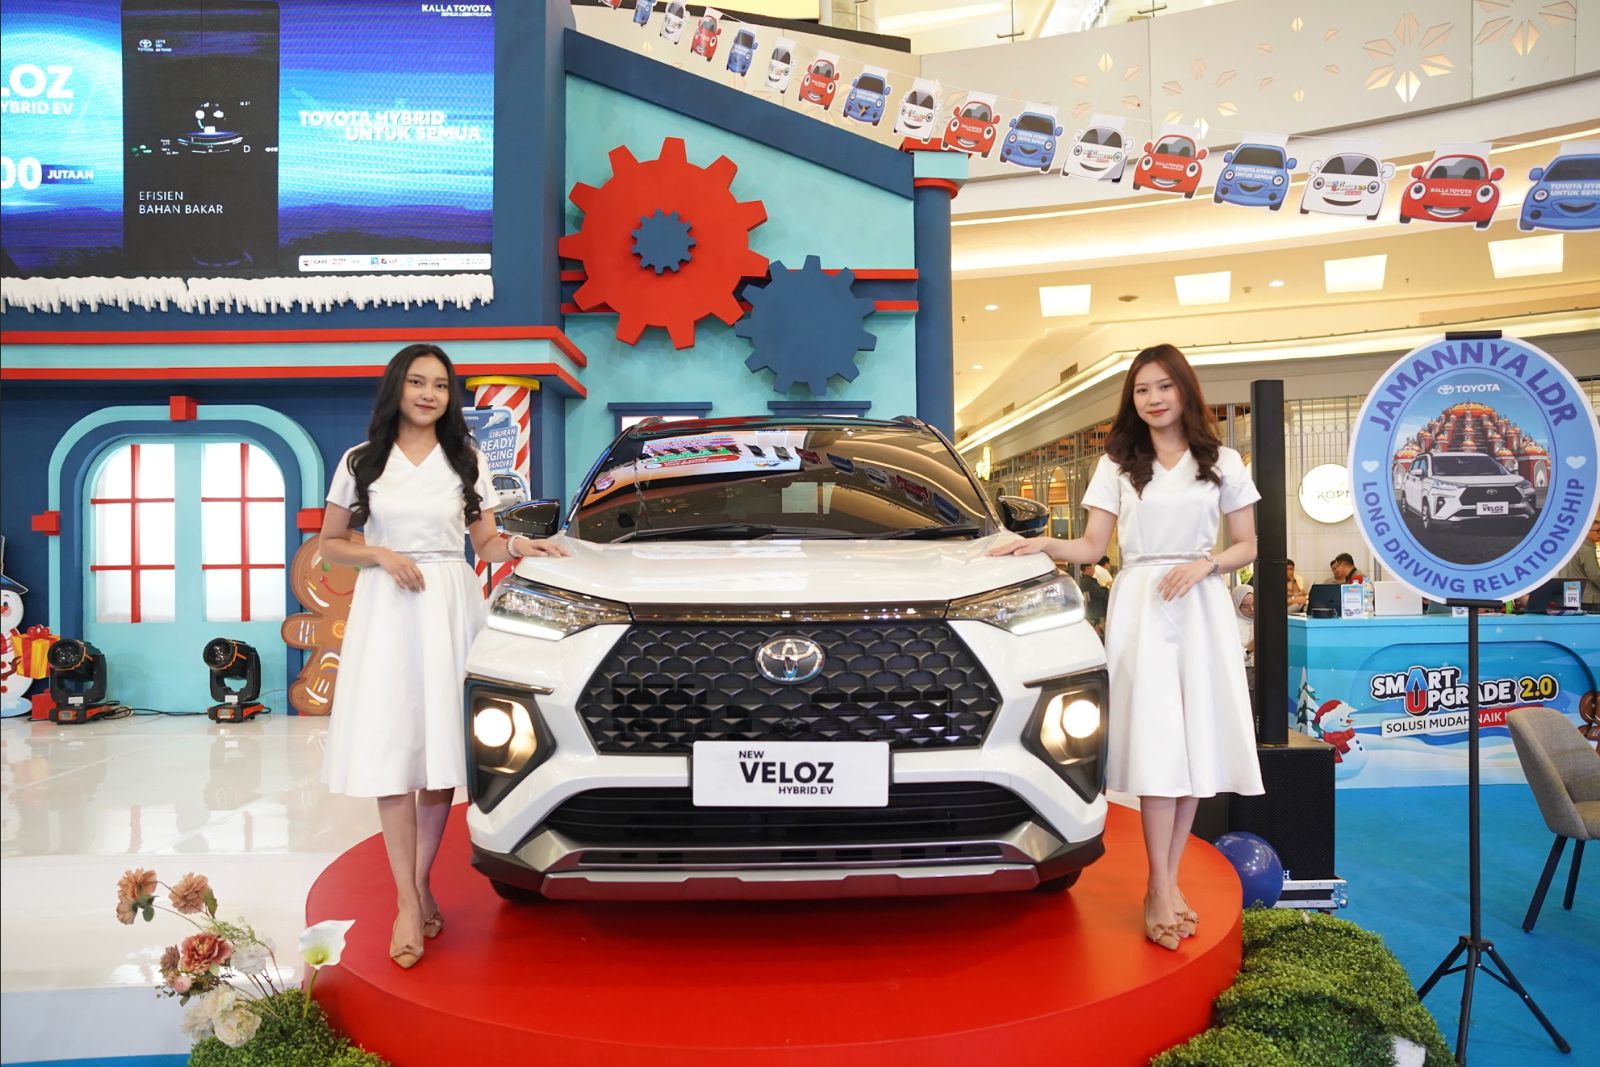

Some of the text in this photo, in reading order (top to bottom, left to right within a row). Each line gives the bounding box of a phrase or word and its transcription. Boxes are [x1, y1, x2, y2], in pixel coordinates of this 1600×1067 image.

[421, 4, 492, 12] KALLA TOYOTA
[52, 102, 75, 115] EV
[299, 110, 445, 126] TOYOTA HYBRID
[345, 126, 481, 141] UNTUK SEMUA
[47, 170, 94, 179] JUTAAN
[139, 191, 184, 200] EFISIEN
[139, 204, 223, 214] BAHAN BAKAR
[1370, 342, 1578, 432] JAMANNYA LDR
[1455, 383, 1501, 393] TOYOTA
[489, 428, 516, 439] LIBURAN
[481, 436, 514, 451] READY.
[1362, 478, 1585, 593] LONG DRIVING RELATIONSHIP
[1372, 668, 1458, 697] SMART
[1519, 677, 1554, 699] 2.0
[1386, 718, 1427, 733] SOLUSI
[1429, 716, 1469, 729] MUDAH
[739, 750, 765, 759] NEW
[739, 762, 834, 784] VELOZ
[778, 786, 834, 795] HYBRID EV
